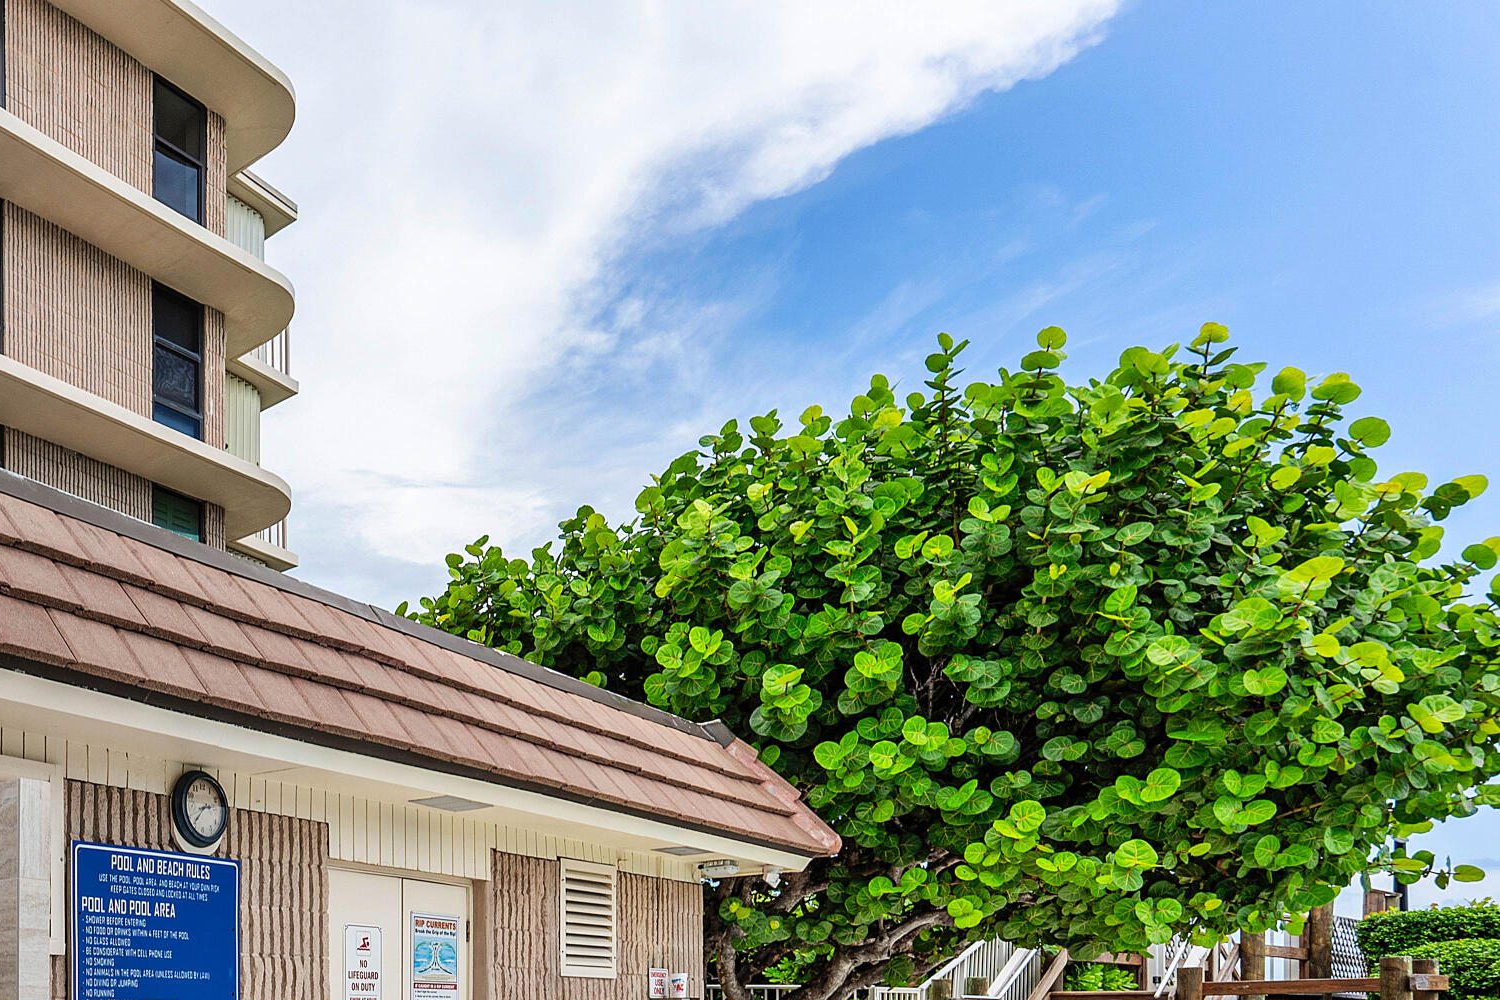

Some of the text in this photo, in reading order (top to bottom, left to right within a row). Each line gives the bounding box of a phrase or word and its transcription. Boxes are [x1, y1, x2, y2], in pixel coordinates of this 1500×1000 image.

[111, 855, 210, 879] POOL AND BEACH RULES
[99, 874, 107, 882] USE
[133, 877, 144, 886] POOL
[169, 881, 182, 889] BEACH
[111, 885, 122, 894] KEEP
[123, 886, 137, 895] GATES
[138, 888, 155, 897] CLOSED
[156, 889, 164, 897] AND
[166, 890, 181, 899] LOCKED
[82, 897, 175, 918] POOL AND POOL AREA
[86, 915, 146, 927] SHOWER BEFORE ENTERING
[427, 921, 456, 930] CURRENTS
[86, 926, 92, 934] NO
[94, 926, 106, 935] FOOD
[107, 927, 113, 936] OR
[115, 928, 131, 936] DRINKS
[132, 929, 147, 937] WITHIN
[153, 930, 162, 938] FEET
[179, 932, 189, 940] POOL
[110, 938, 131, 946] ALLOWED
[86, 947, 91, 955] BE
[93, 947, 124, 956] CONSIDERATE
[125, 949, 136, 957] WITH
[138, 949, 147, 957] CELL
[149, 950, 162, 958] PHONE
[94, 958, 114, 966] SMOKING
[360, 960, 367, 968] NO
[94, 969, 114, 977] ANIMALS
[131, 970, 141, 978] POOL
[143, 970, 154, 978] AREA
[155, 970, 173, 979] (UNLESS
[174, 971, 192, 979] ALLOWED
[348, 971, 378, 980] LIFEGUARD
[118, 979, 138, 987] JUMPING
[352, 983, 375, 991] ON DUTY
